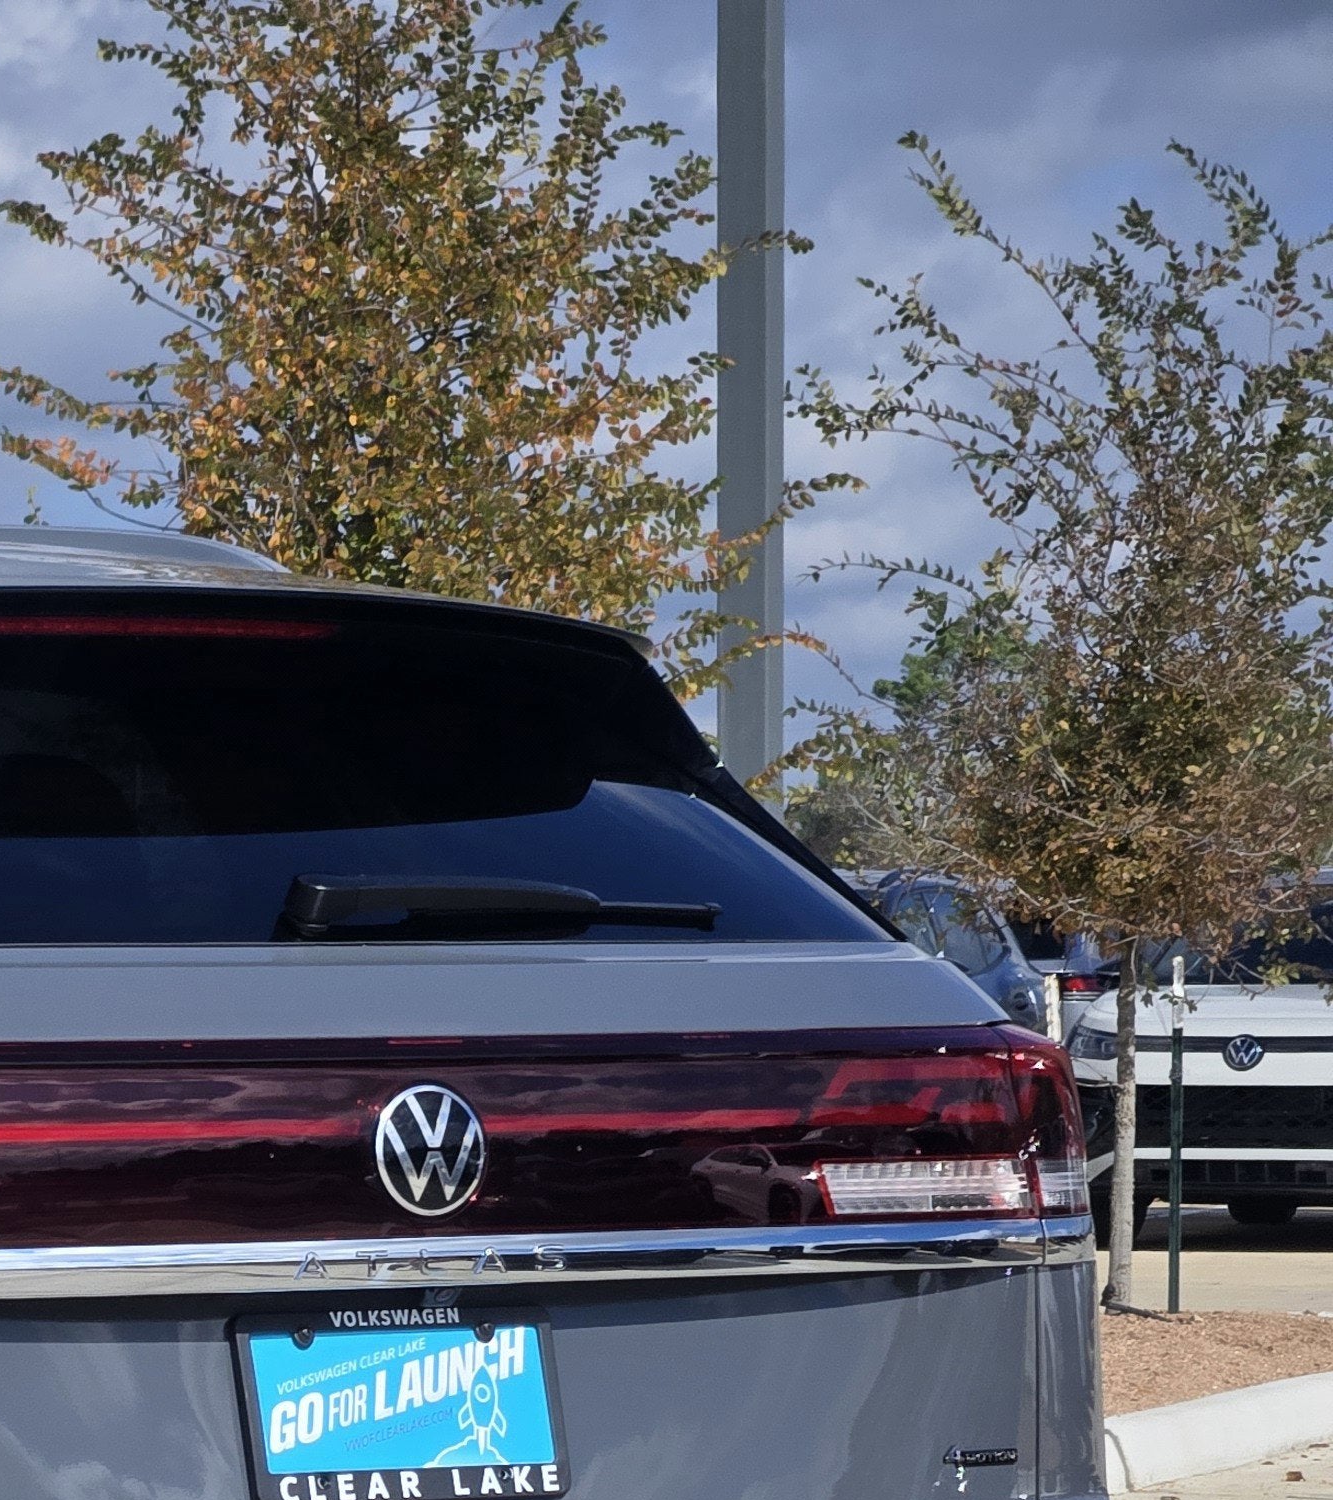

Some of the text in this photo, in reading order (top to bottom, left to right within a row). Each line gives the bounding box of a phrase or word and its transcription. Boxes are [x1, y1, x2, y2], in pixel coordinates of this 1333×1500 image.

[380, 1089, 484, 1209] VW
[292, 1243, 568, 1281] ATLAS
[329, 1307, 460, 1328] VOLKSWAGEN
[269, 1326, 526, 1455] GO FOR LAUNCH
[276, 1336, 427, 1396] VOLKSWAGEN CLEAR LAKE
[452, 1464, 561, 1497] LAKE
